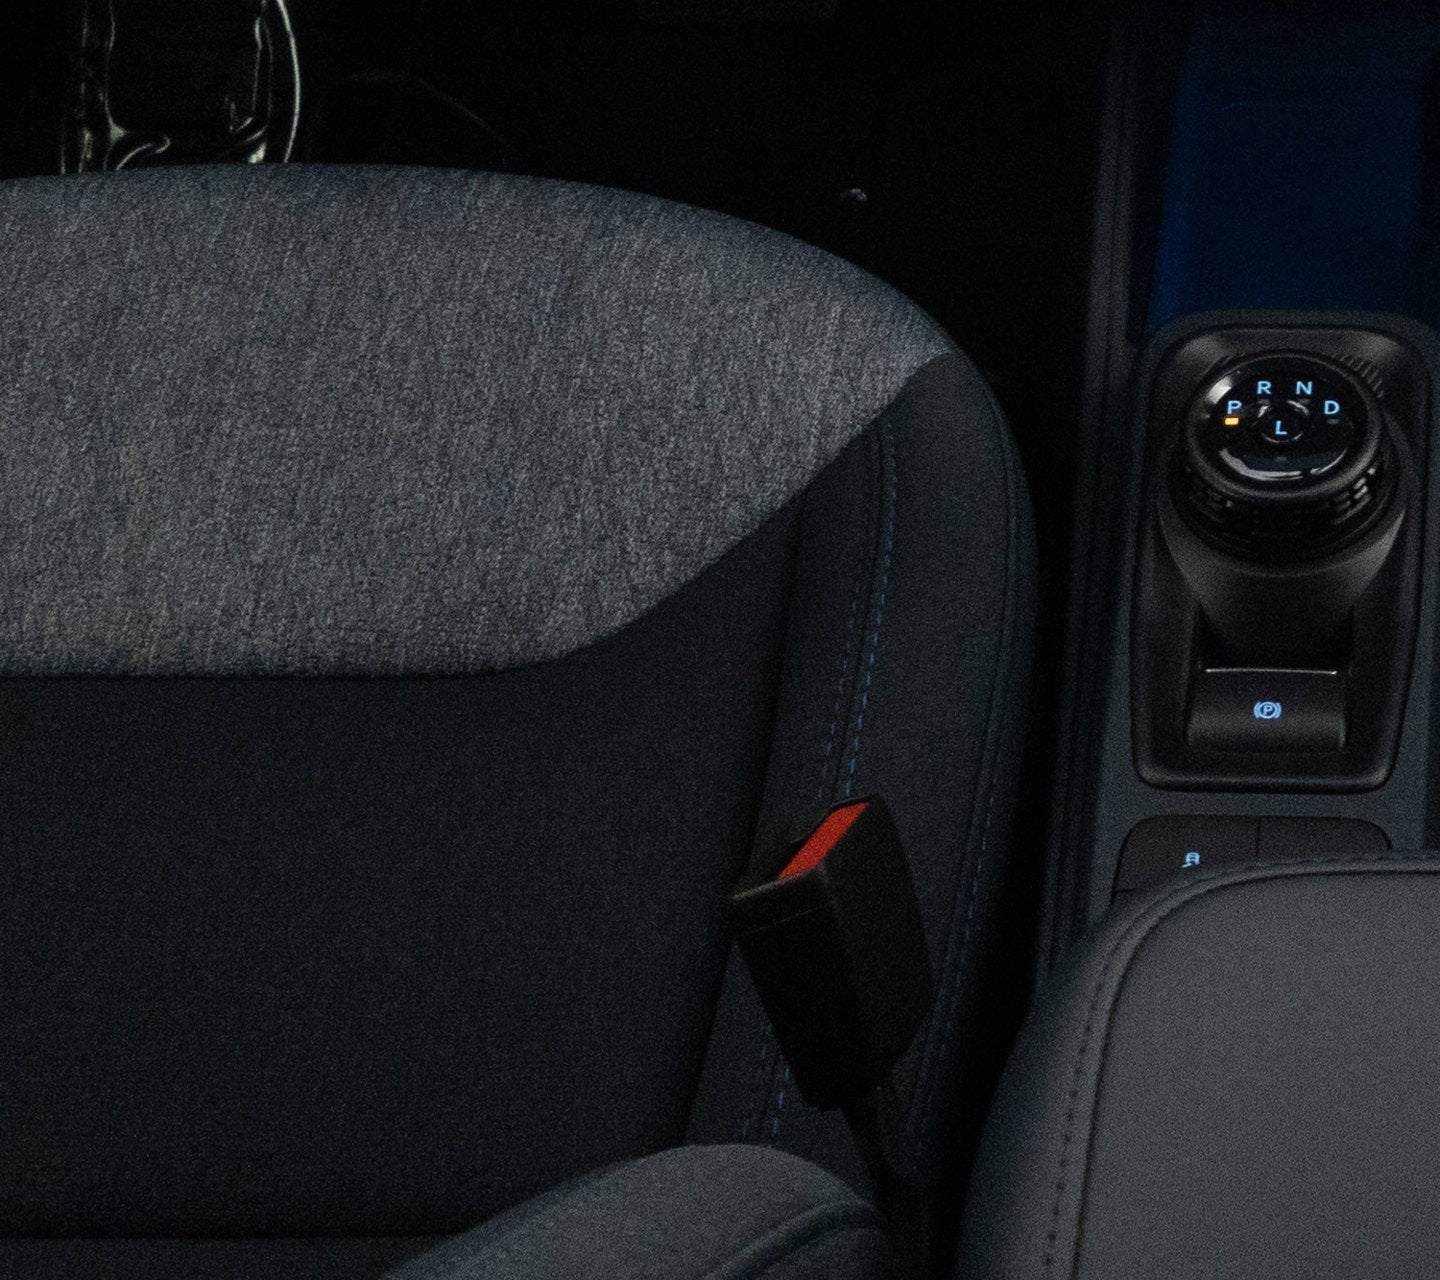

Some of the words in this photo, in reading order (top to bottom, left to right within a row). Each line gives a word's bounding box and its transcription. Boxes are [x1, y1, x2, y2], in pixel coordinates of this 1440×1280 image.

[1257, 380, 1272, 395] R
[1296, 381, 1313, 395] N
[1227, 400, 1242, 415] P
[1324, 400, 1340, 415] D
[1275, 420, 1288, 435] L
